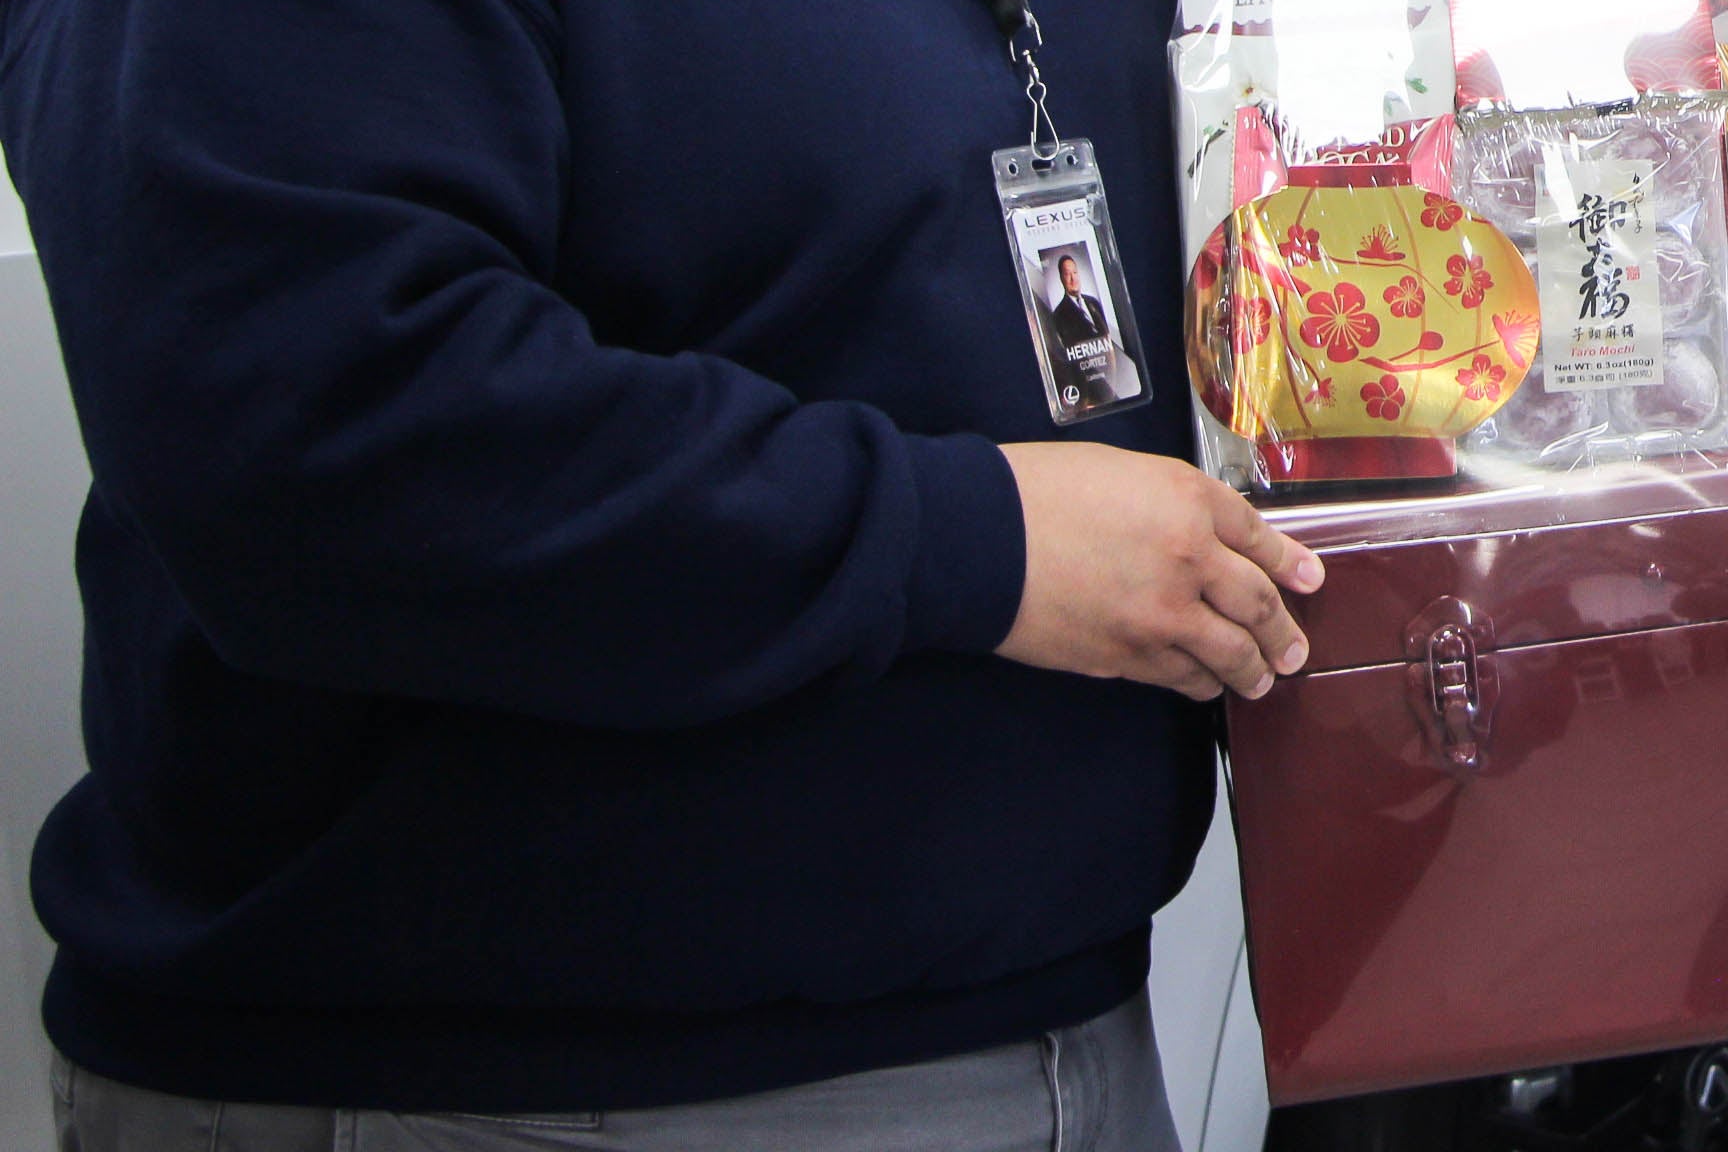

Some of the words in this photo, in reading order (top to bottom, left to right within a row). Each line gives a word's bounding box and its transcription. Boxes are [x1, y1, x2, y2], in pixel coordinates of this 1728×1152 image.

[1025, 208, 1085, 228] LEXUS
[1066, 338, 1113, 361] HERNAN
[1600, 344, 1636, 355] Mochi
